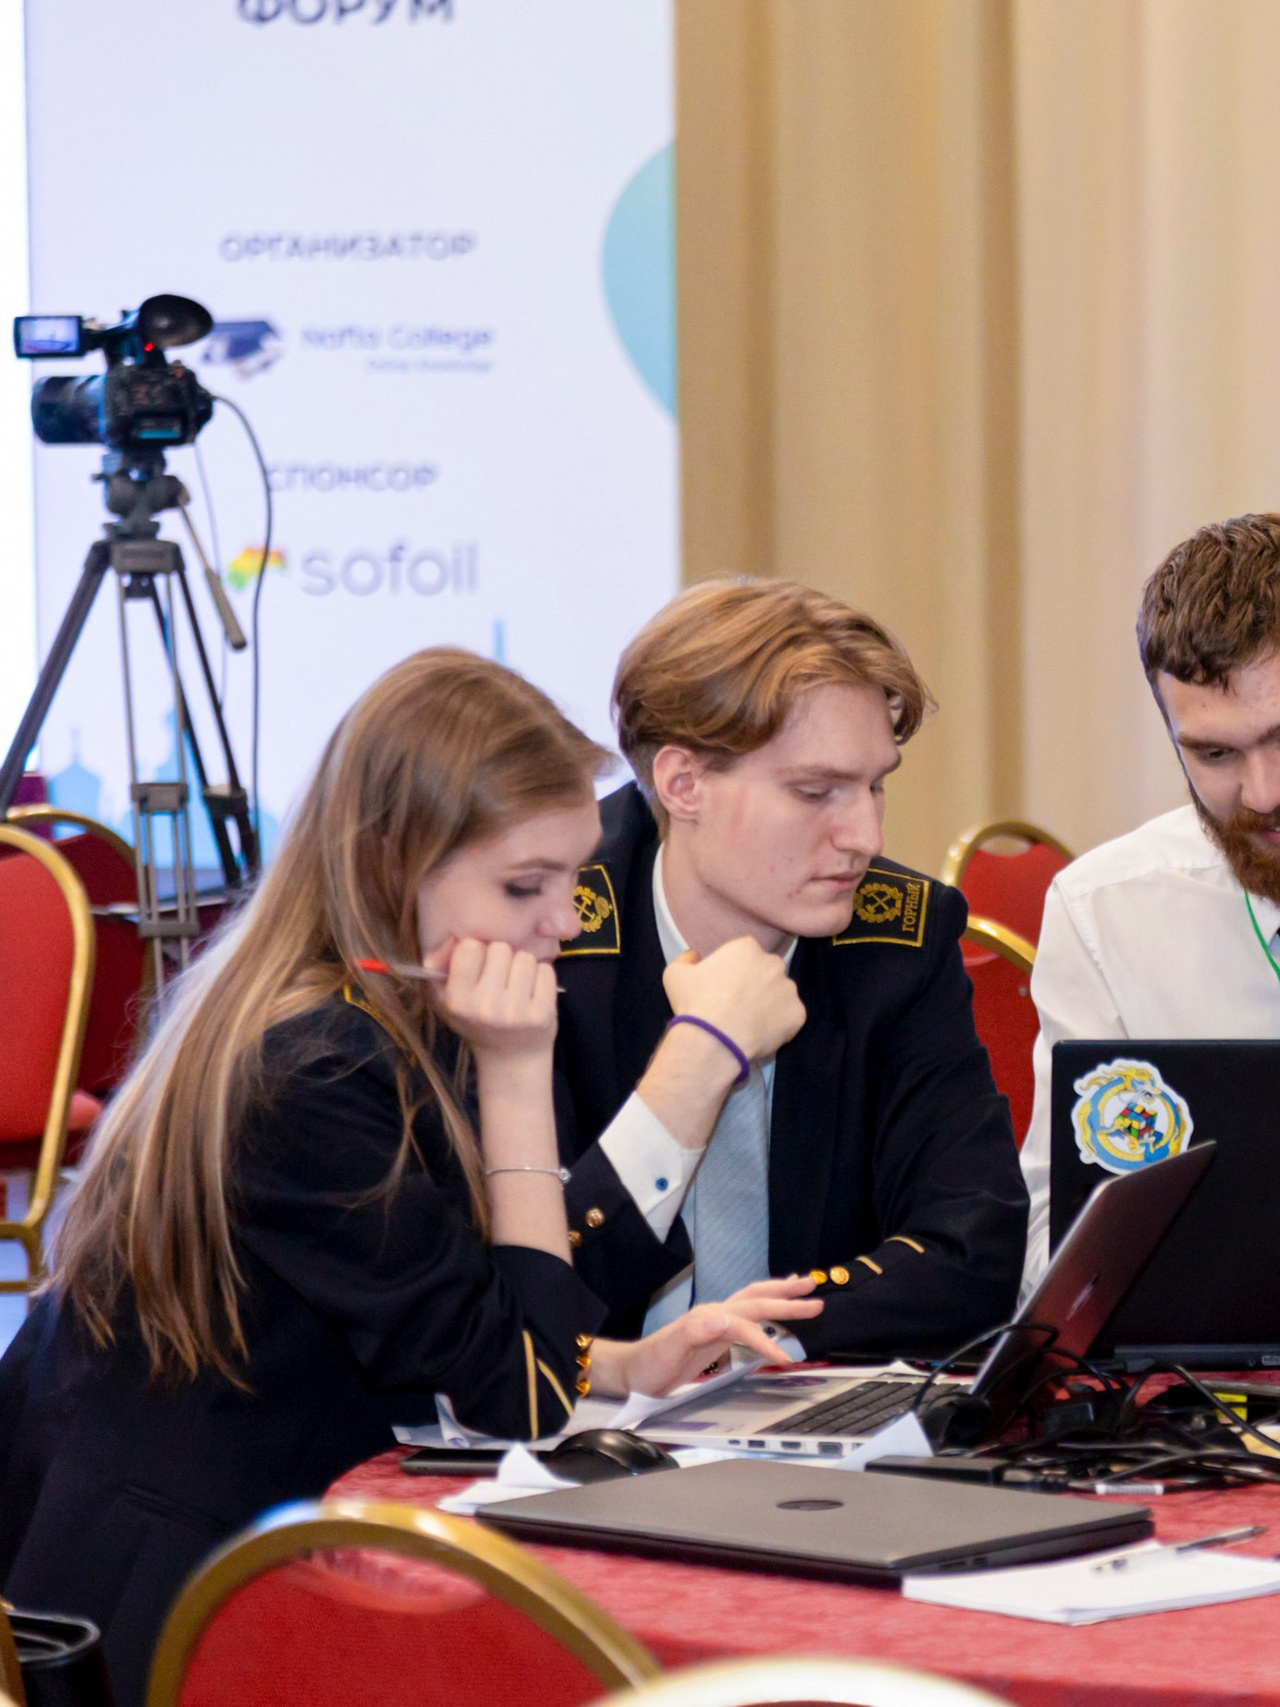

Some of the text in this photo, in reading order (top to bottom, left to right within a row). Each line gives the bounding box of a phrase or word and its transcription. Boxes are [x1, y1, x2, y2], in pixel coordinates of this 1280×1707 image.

[237, 0, 455, 26] ФОРУМ
[218, 233, 476, 262] ОРГАНИЗАТОР
[266, 464, 438, 492] СПОНСОР
[301, 541, 479, 597] sofoil
